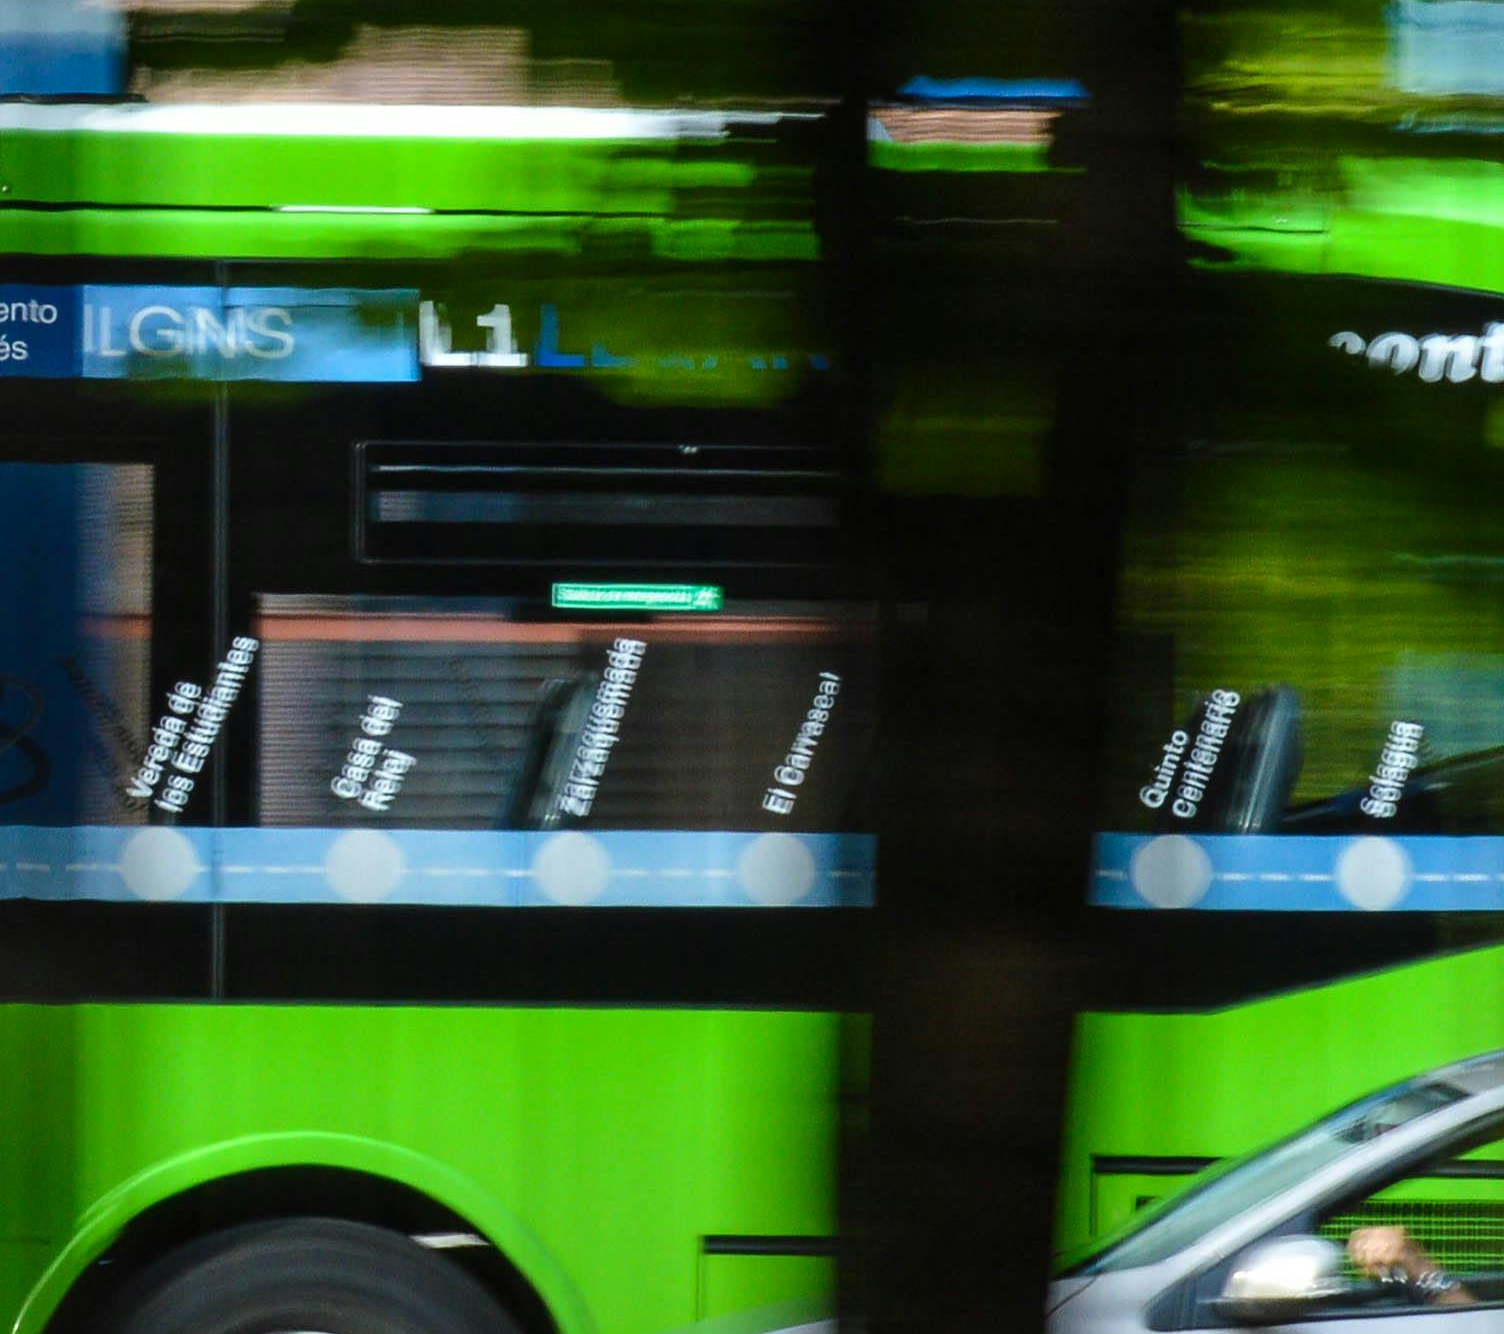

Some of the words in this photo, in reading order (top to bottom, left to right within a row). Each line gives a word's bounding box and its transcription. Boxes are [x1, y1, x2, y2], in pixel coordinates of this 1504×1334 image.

[126, 715, 187, 797] Vereda
[166, 681, 202, 714] de
[171, 636, 259, 773] Estudiantes
[330, 736, 383, 799] Casa
[359, 694, 404, 736] del
[556, 637, 647, 817] Zarzaquemada
[154, 774, 194, 812] los
[762, 788, 797, 815] El
[1139, 729, 1188, 808] Quinto
